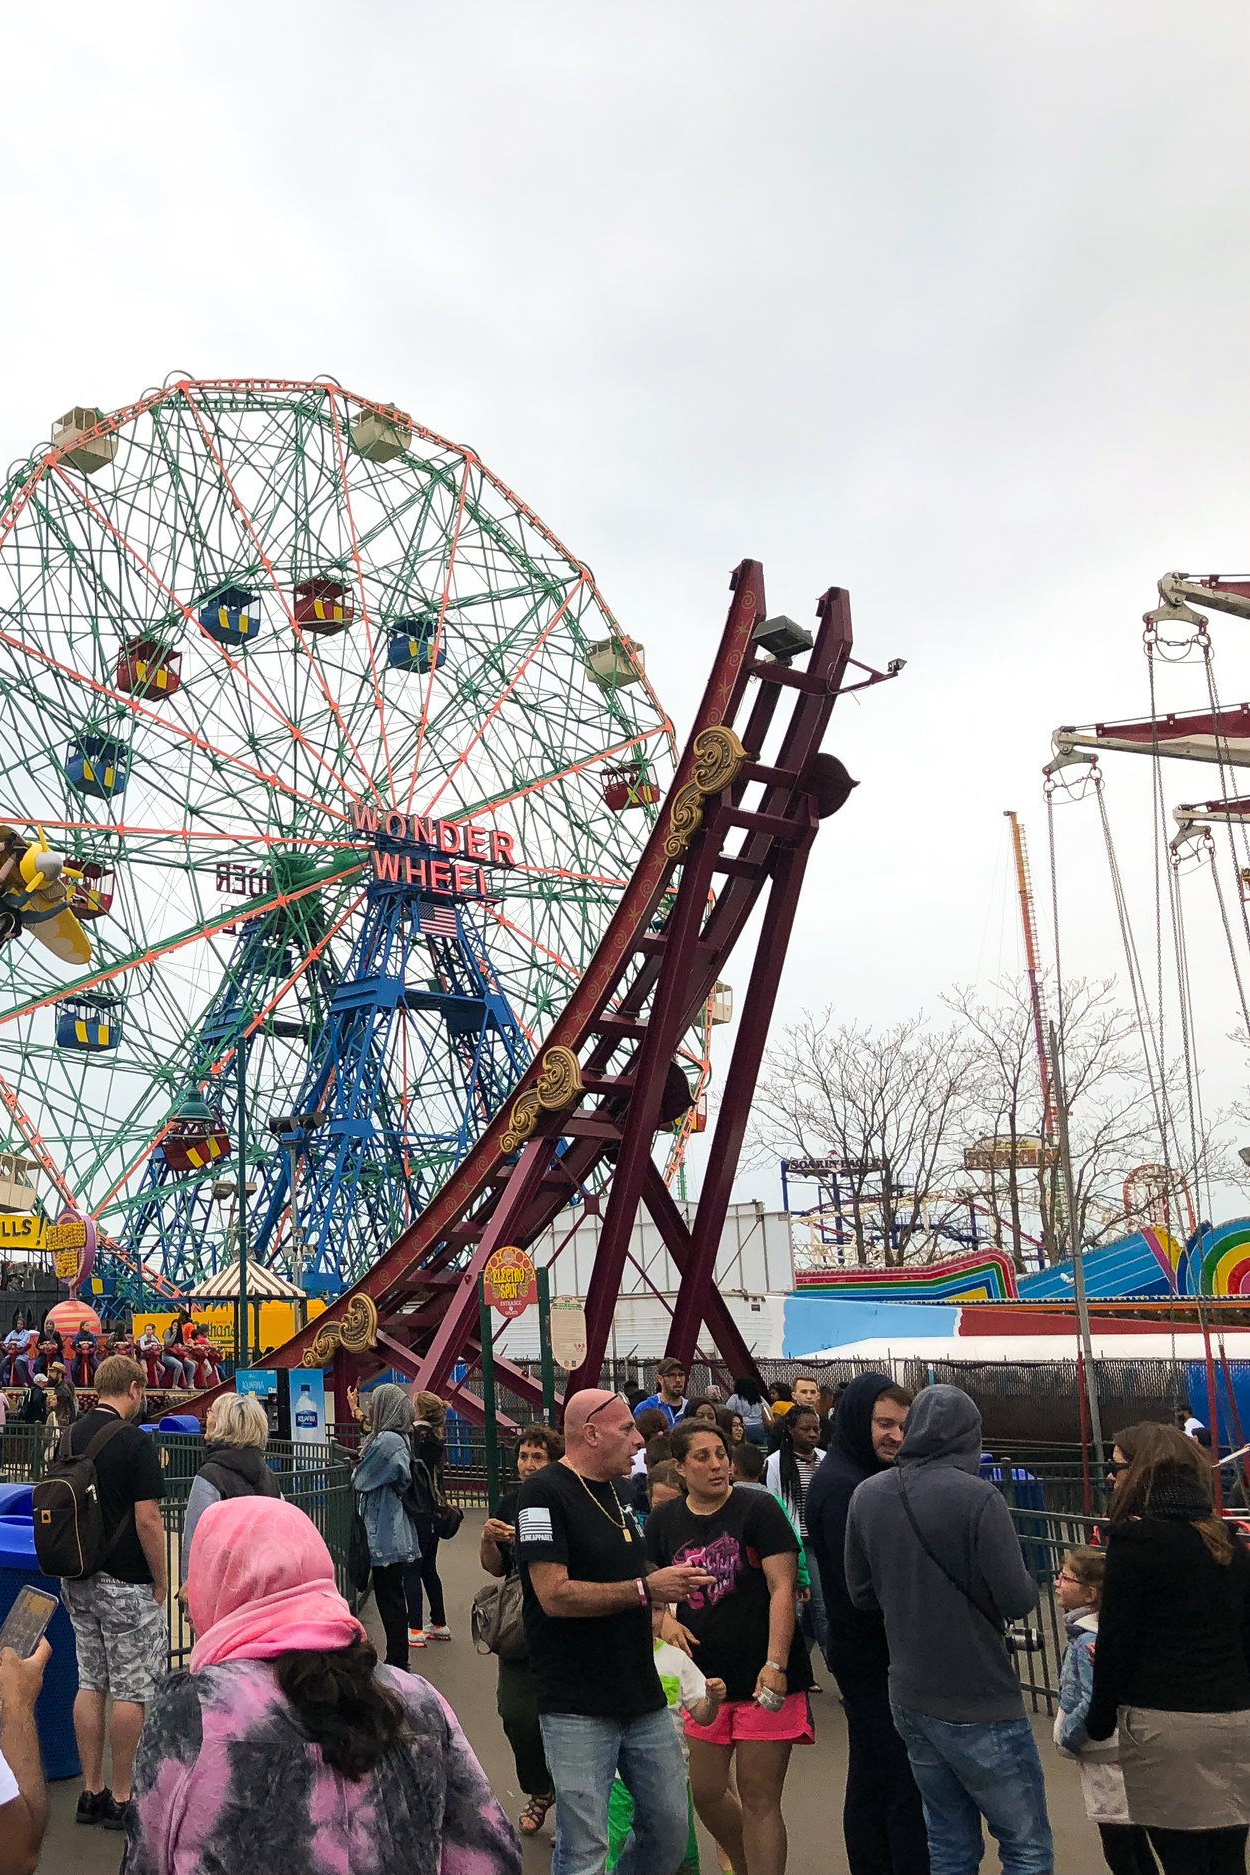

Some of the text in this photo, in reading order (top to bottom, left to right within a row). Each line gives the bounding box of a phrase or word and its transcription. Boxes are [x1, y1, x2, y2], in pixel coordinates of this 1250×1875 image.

[350, 801, 515, 865] WONDER
[371, 849, 502, 903] WHEEL
[493, 1267, 525, 1283] ELECTRO
[500, 1282, 518, 1299] SPIN
